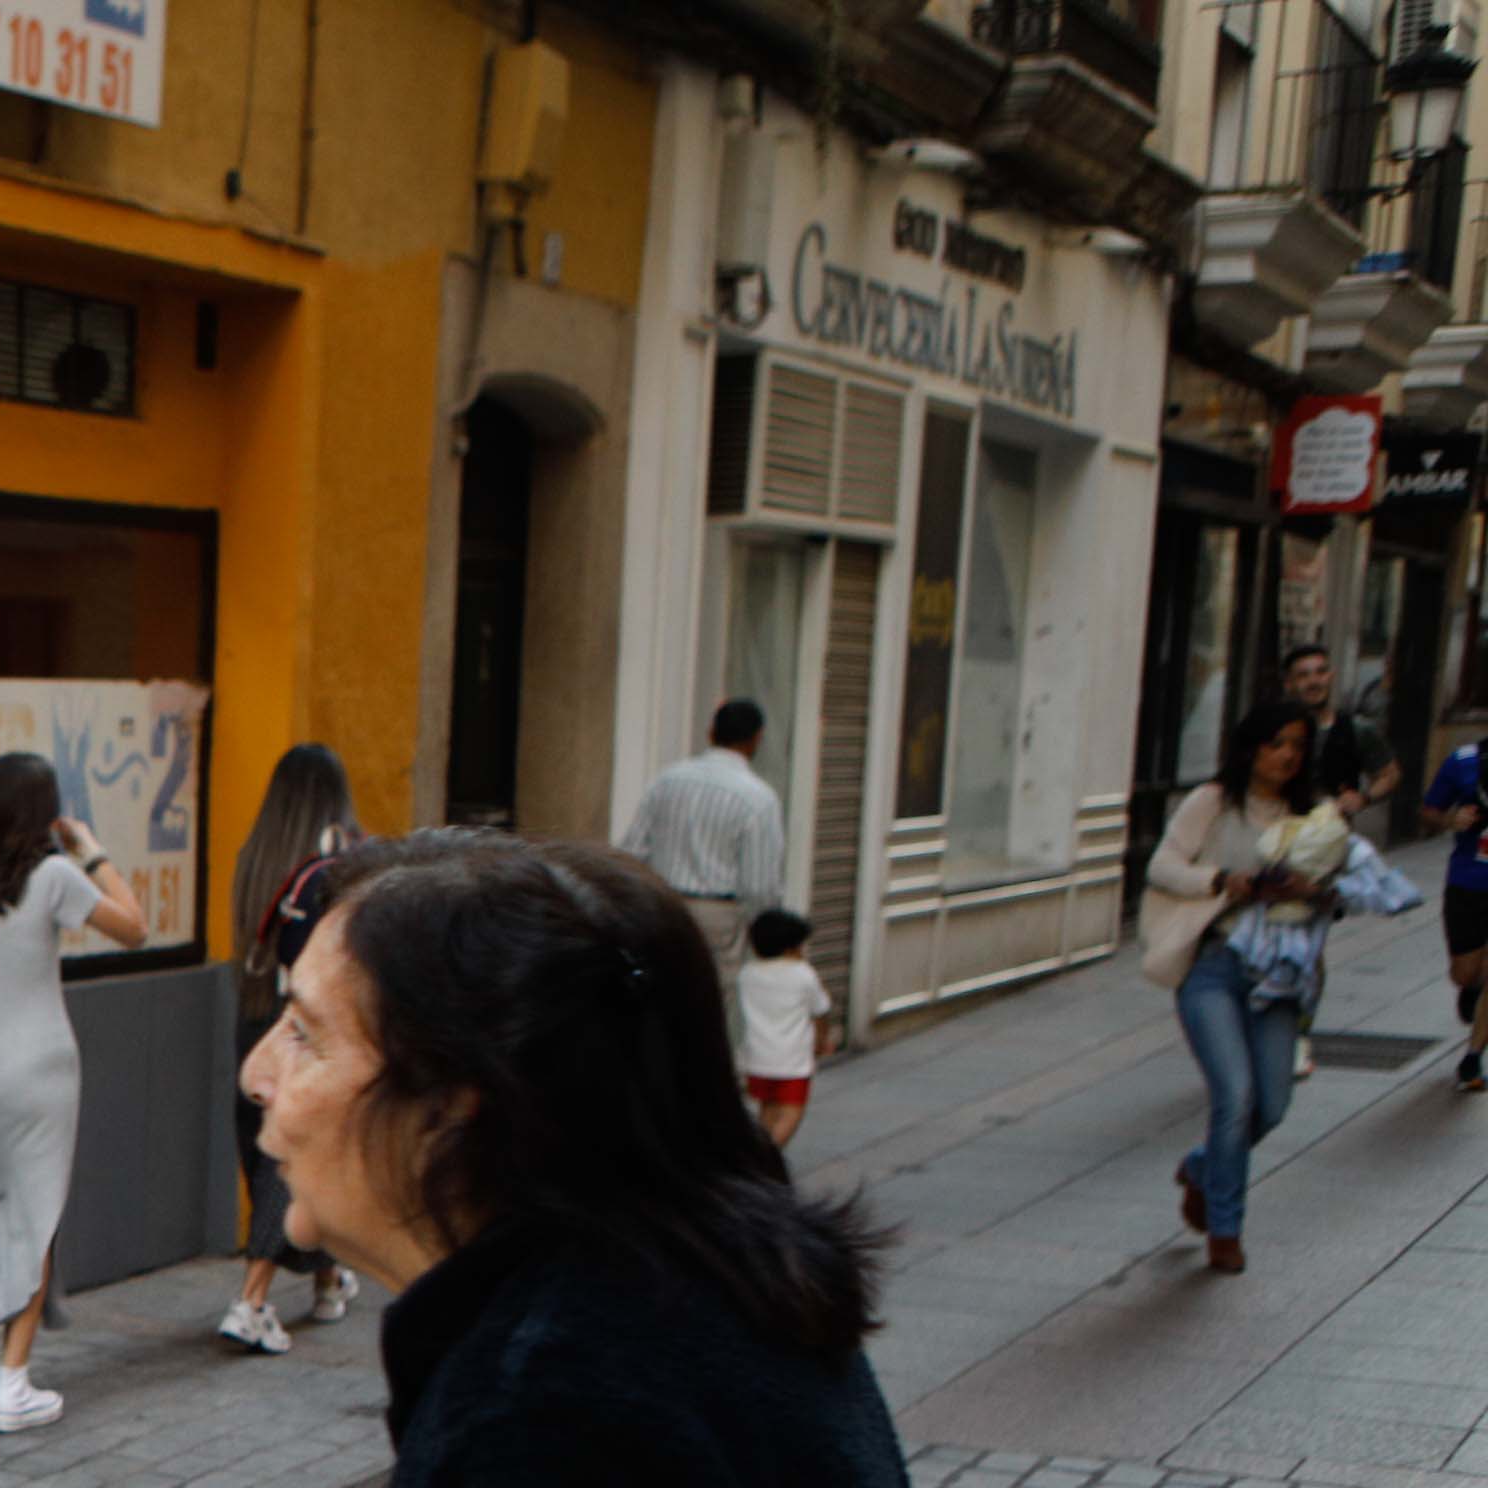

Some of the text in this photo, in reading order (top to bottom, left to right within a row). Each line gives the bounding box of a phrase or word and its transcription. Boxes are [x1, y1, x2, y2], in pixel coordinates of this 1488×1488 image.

[10, 15, 43, 89] 10
[55, 29, 90, 99] 31
[100, 43, 134, 115] 51
